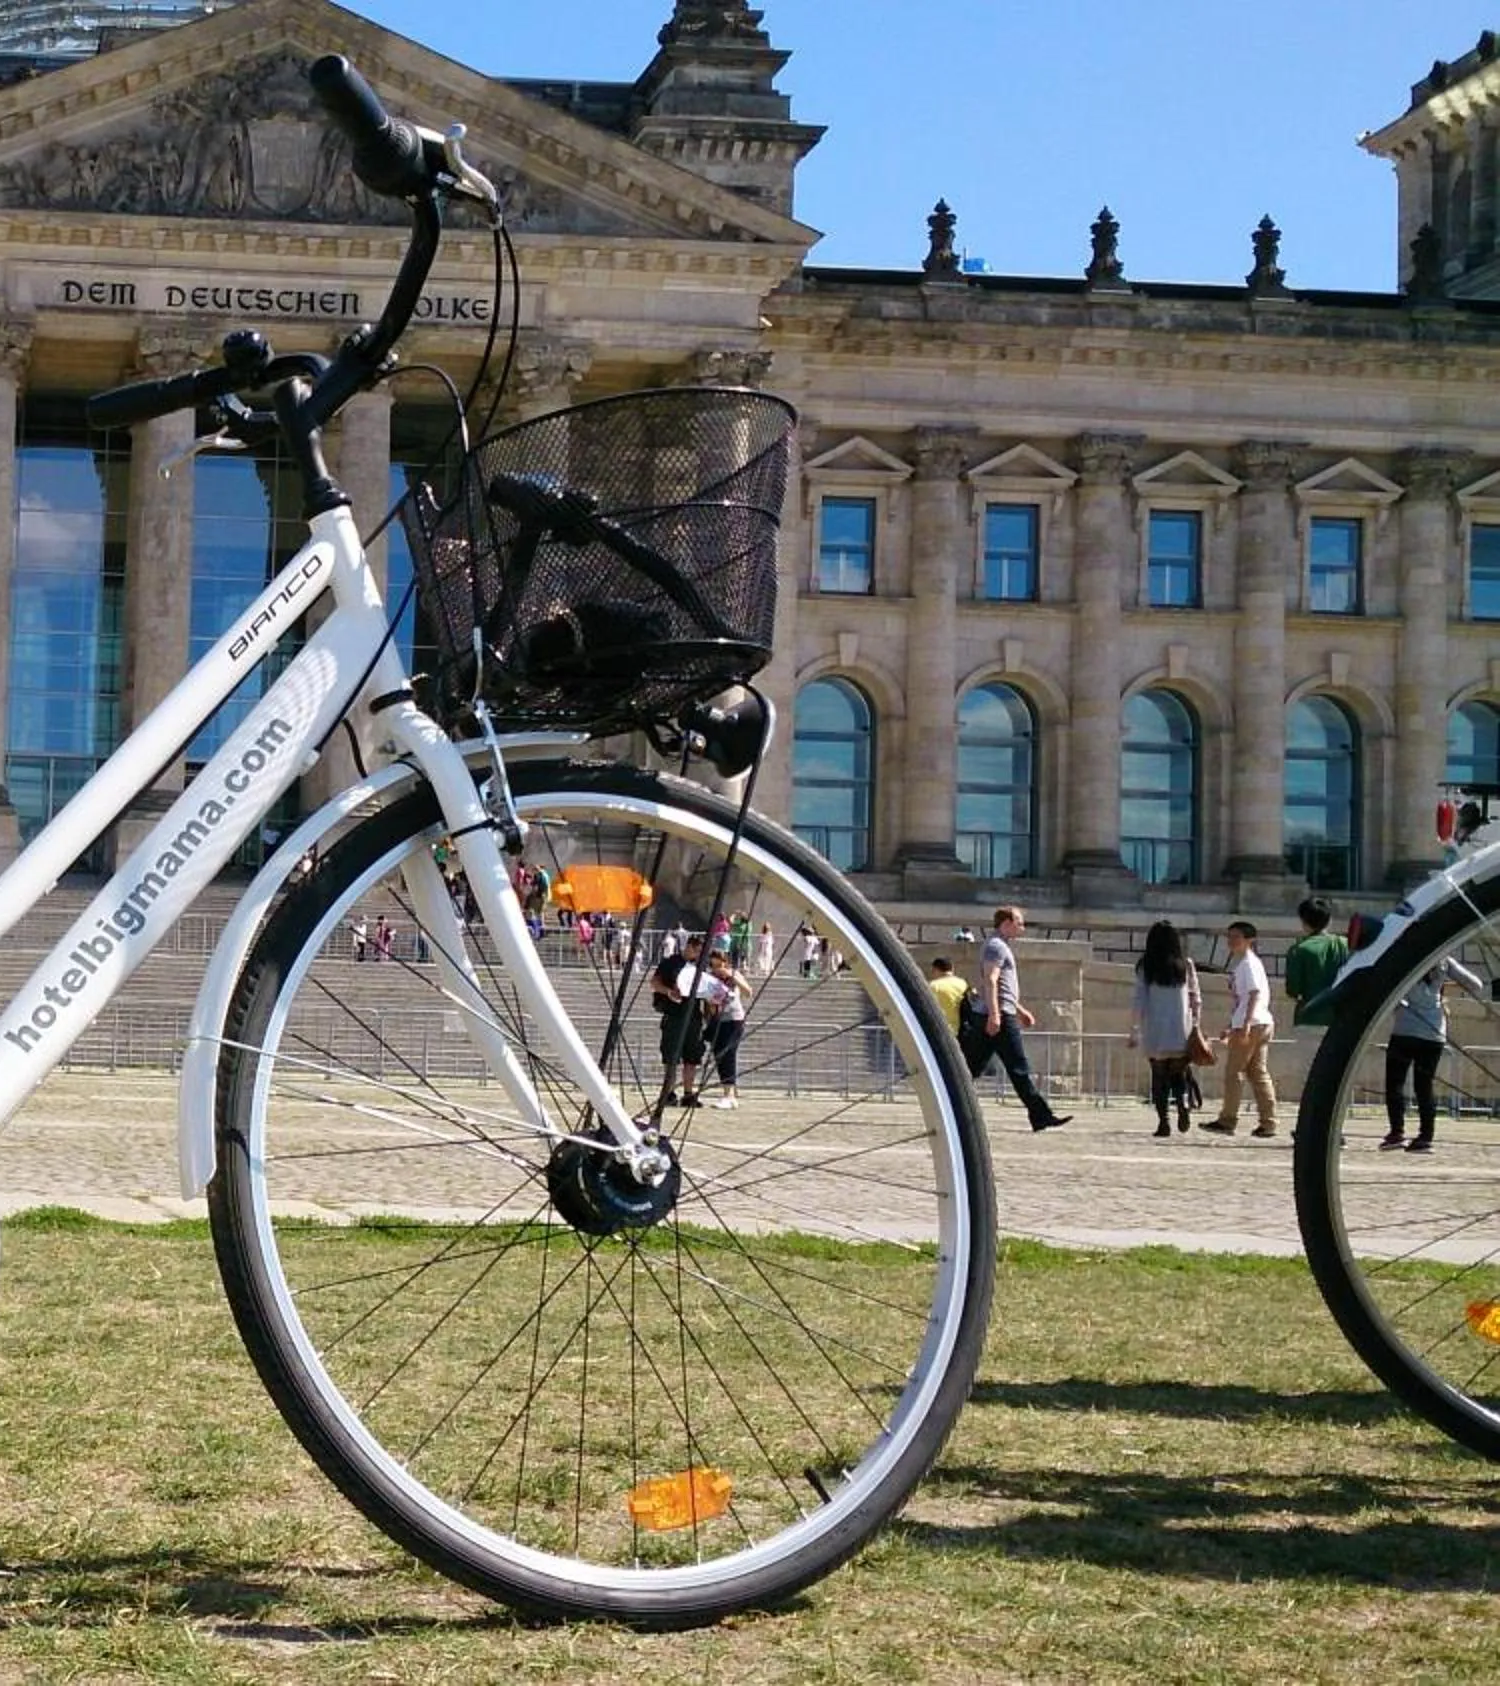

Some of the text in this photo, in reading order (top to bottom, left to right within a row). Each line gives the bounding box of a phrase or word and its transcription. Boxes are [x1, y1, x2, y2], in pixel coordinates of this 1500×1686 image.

[62, 280, 490, 320] DEM DEUTSCHEN OLKE
[228, 554, 323, 662] BIANCO
[4, 716, 293, 1055] hotelbigmama.com
